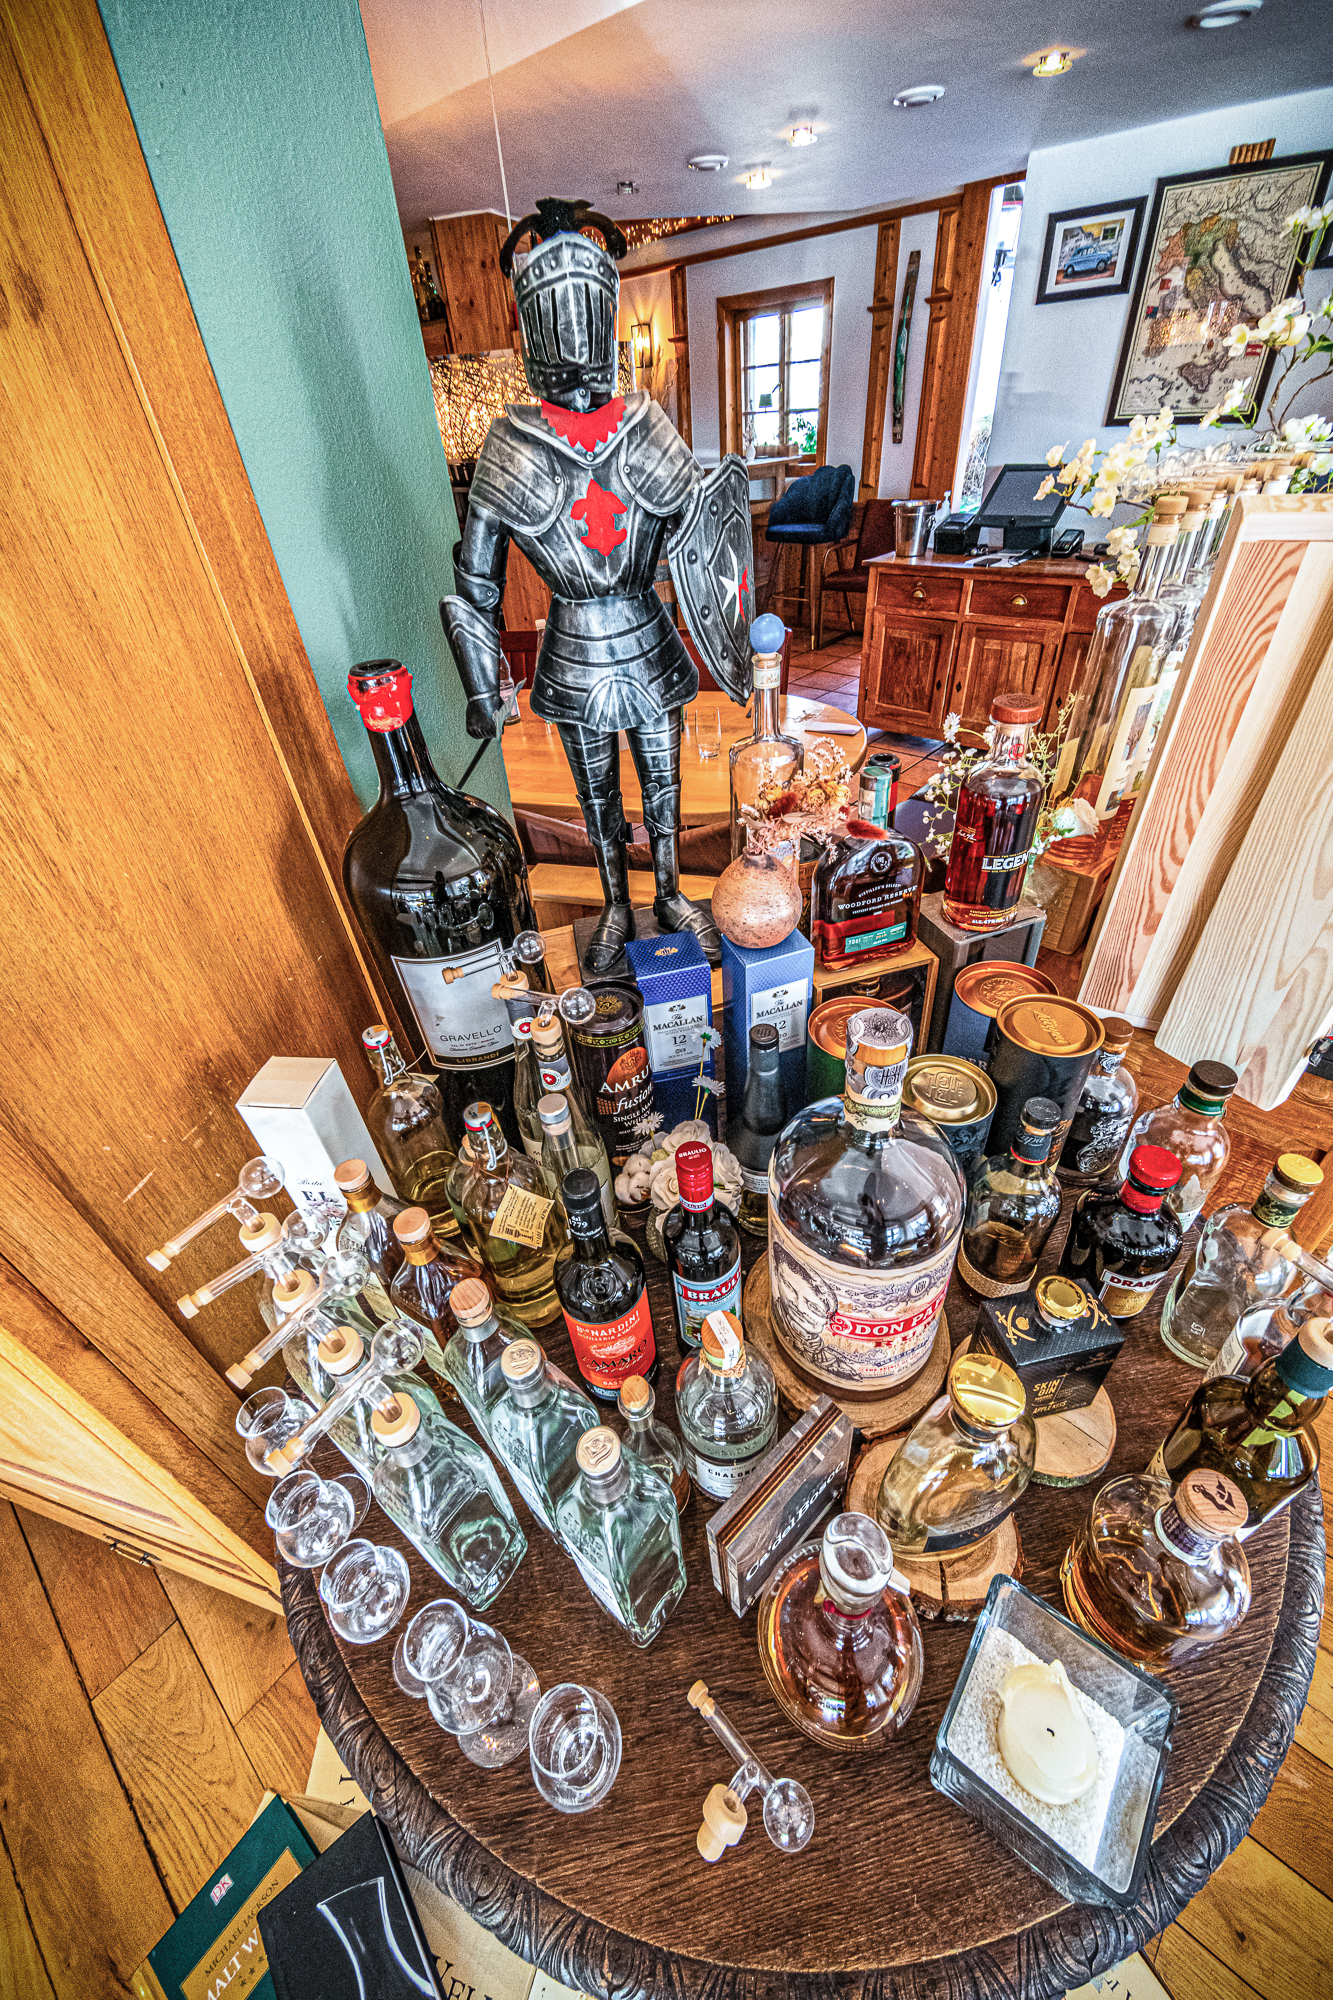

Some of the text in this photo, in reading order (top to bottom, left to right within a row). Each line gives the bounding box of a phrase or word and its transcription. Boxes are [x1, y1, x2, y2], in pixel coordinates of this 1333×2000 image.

[838, 884, 918, 911] WOODFORD RESERVE
[756, 999, 804, 1019] MACALLAN
[653, 1015, 704, 1032] MACALLAN
[440, 1025, 502, 1042] GRAVELLO
[672, 1034, 687, 1046] 12
[612, 1082, 652, 1115] fusion
[613, 1109, 640, 1123] SINGLE
[678, 1147, 707, 1158] BRAULIO
[591, 1310, 640, 1337] NARDINI
[854, 1321, 905, 1336] DON
[1033, 1379, 1061, 1392] SKIN
[1037, 1386, 1057, 1396] GIN
[212, 1874, 233, 1900] DK
[204, 1879, 280, 1977] MICHAEL JACKSON
